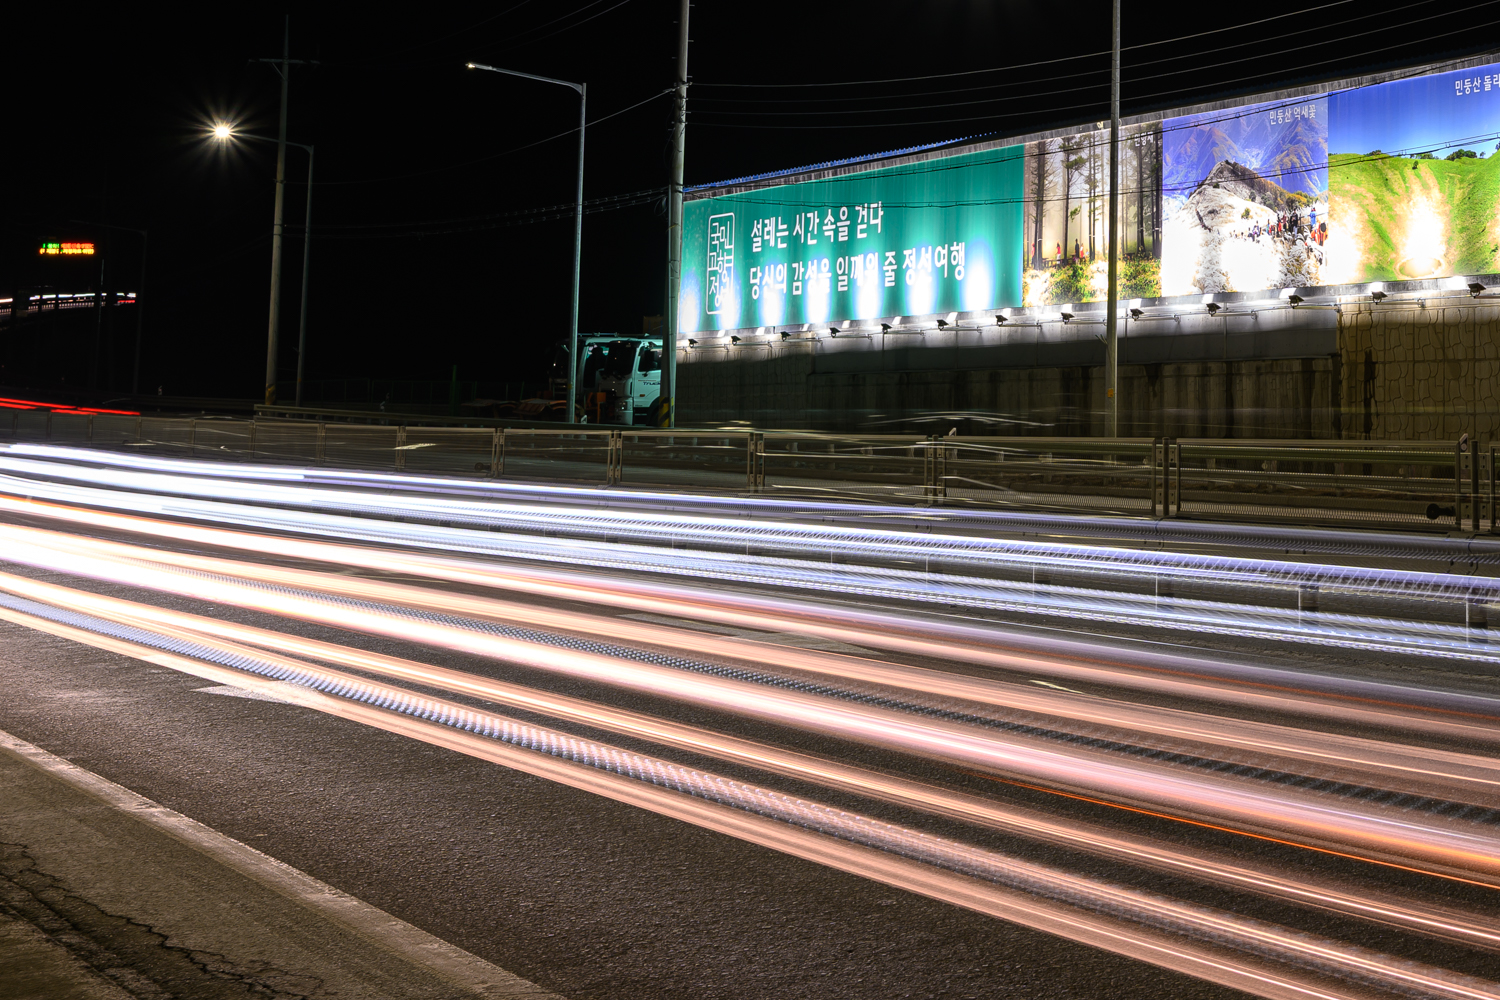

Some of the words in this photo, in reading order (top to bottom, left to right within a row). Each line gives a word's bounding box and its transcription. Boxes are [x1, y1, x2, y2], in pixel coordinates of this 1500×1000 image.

[1455, 77, 1482, 96] 민둥산
[1269, 108, 1292, 125] 민둥산
[1293, 104, 1316, 121] 억새꽃
[751, 217, 789, 253] 설레는
[793, 211, 820, 245] 시간
[822, 206, 851, 242] 속을
[855, 201, 884, 239] 걷다
[749, 263, 788, 300] 당신의
[883, 251, 898, 287] 줄
[902, 241, 966, 286] 정선여행
